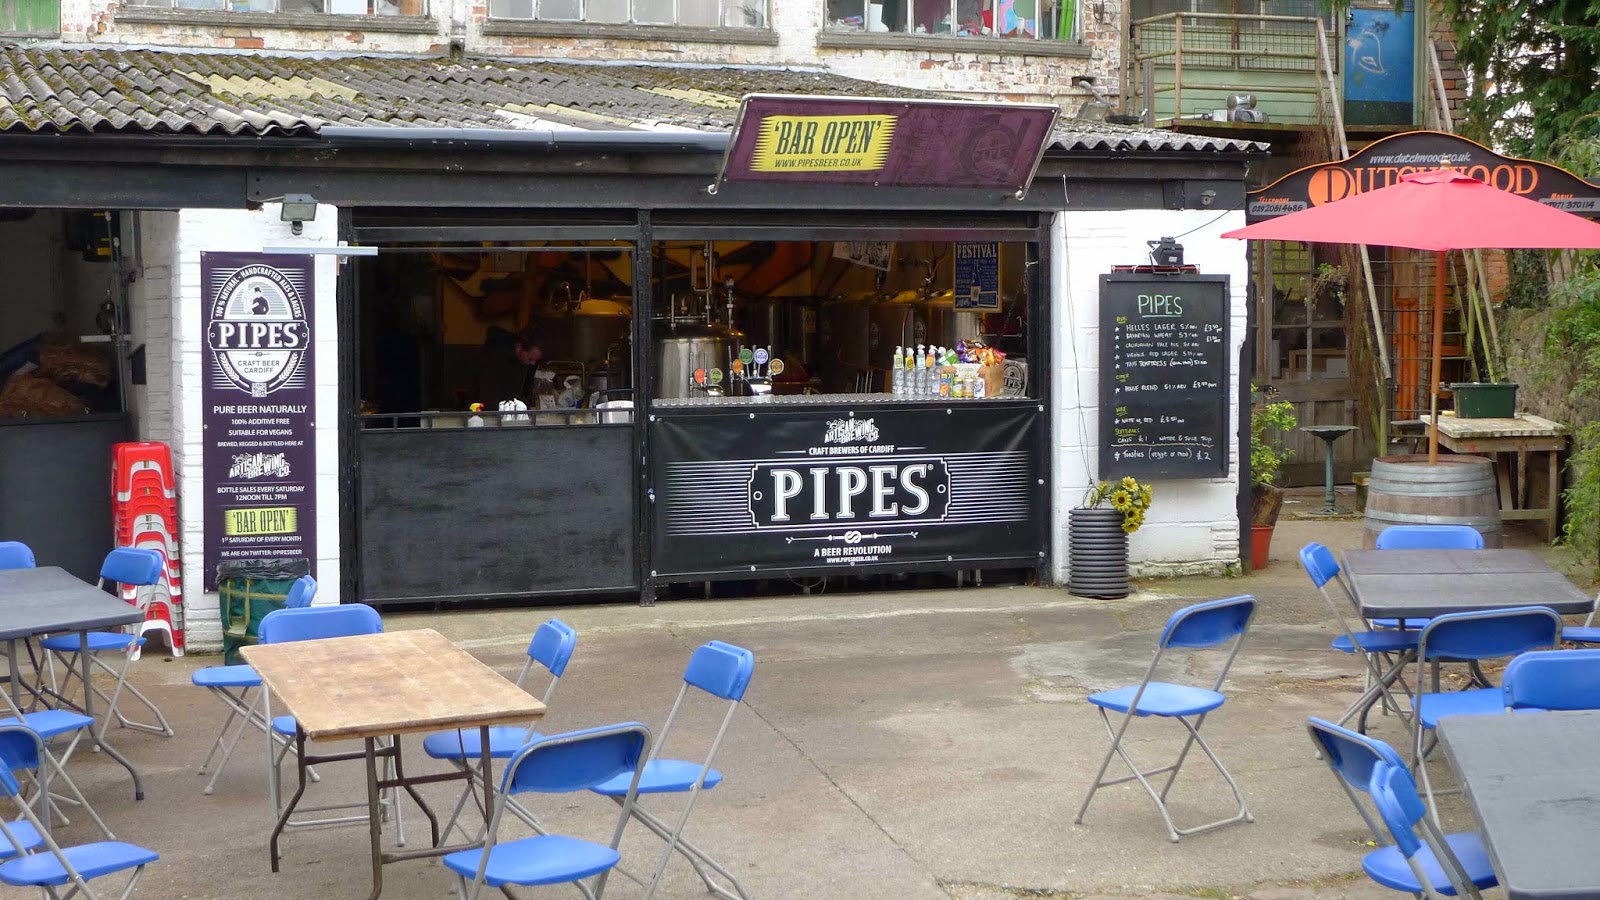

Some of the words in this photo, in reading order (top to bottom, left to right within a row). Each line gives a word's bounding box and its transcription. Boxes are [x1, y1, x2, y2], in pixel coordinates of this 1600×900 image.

[774, 120, 817, 155] 'BAR
[820, 120, 882, 154] OPEN'
[775, 158, 863, 168] WWW.PIPESBEER.CO.UK
[1369, 152, 1471, 164] www.dutchwoodco.uk
[957, 244, 997, 258] FESTIVAL
[221, 277, 240, 301] NATURAL
[240, 266, 281, 282] HANDCRAFTED
[280, 279, 291, 292] ALES
[291, 296, 302, 318] LAGERS
[1138, 294, 1183, 315] PIPES
[218, 322, 300, 348] PIPES
[1004, 378, 1022, 387] IPES
[260, 405, 307, 413] NATURALLY
[824, 418, 854, 444] ARTISAN
[841, 418, 874, 444] BREWING
[809, 447, 828, 455] CRAFT
[829, 446, 859, 454] BREWERS
[869, 444, 895, 453] CARDIFF
[229, 452, 262, 478] ARTISAN
[248, 452, 285, 479] BREWING
[770, 464, 930, 522] PIPES
[233, 511, 256, 533] 'BAR
[260, 510, 289, 532] OPEN'
[814, 548, 820, 557] A
[821, 547, 841, 557] BEER
[842, 545, 892, 556] REVOLUTION
[826, 555, 878, 563] WWW.PIPESBEER.CO.UK
